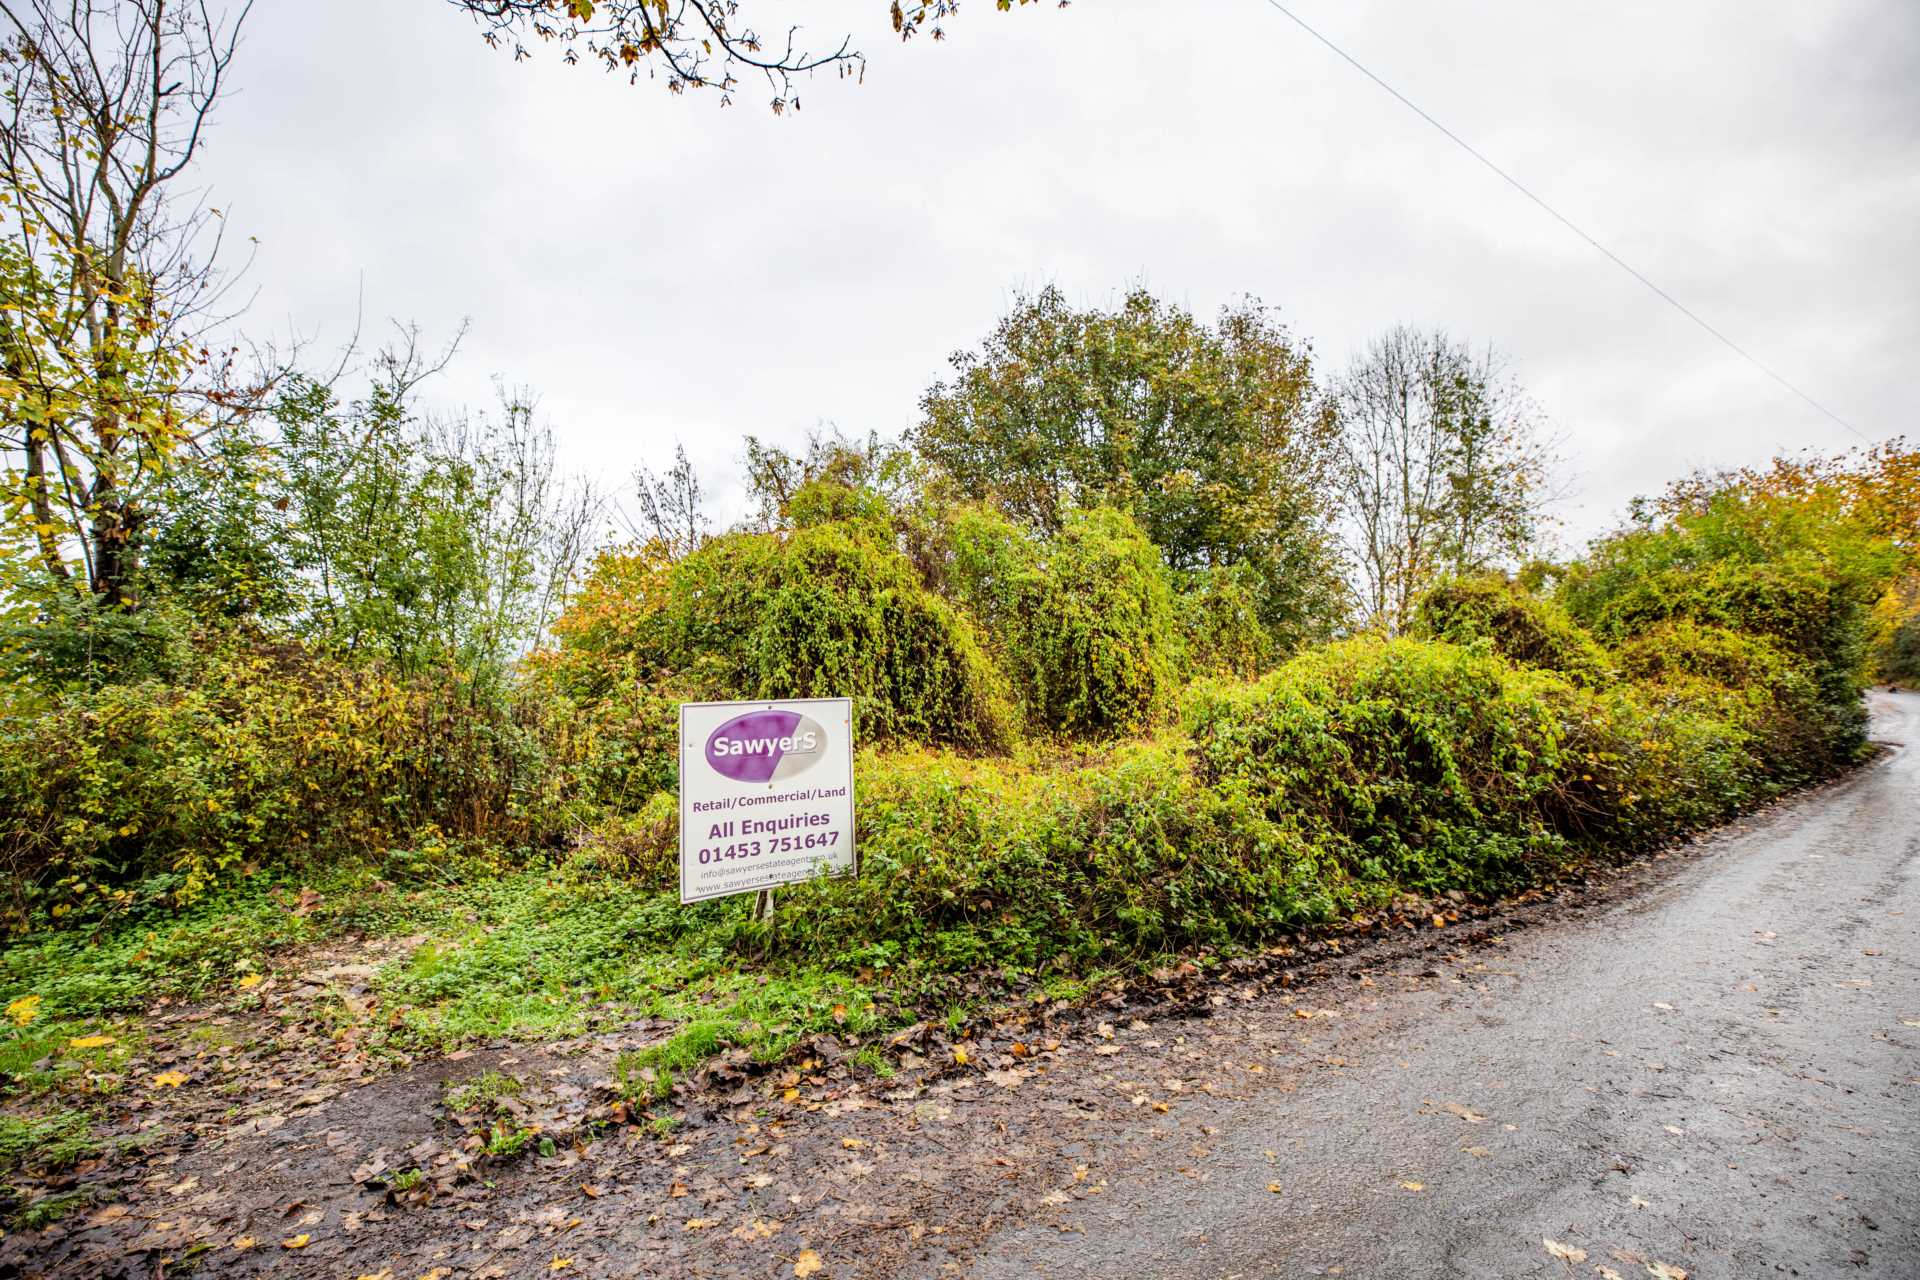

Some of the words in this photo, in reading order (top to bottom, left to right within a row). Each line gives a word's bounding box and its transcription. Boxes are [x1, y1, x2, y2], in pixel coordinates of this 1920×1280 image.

[693, 786, 846, 812] Retail/Commercial/Land
[708, 821, 734, 839] All
[742, 813, 830, 834] Enquiries
[699, 841, 761, 864] 01453
[769, 831, 839, 854] 751647
[696, 863, 842, 893] www.sawyersesateagen.c.uk
